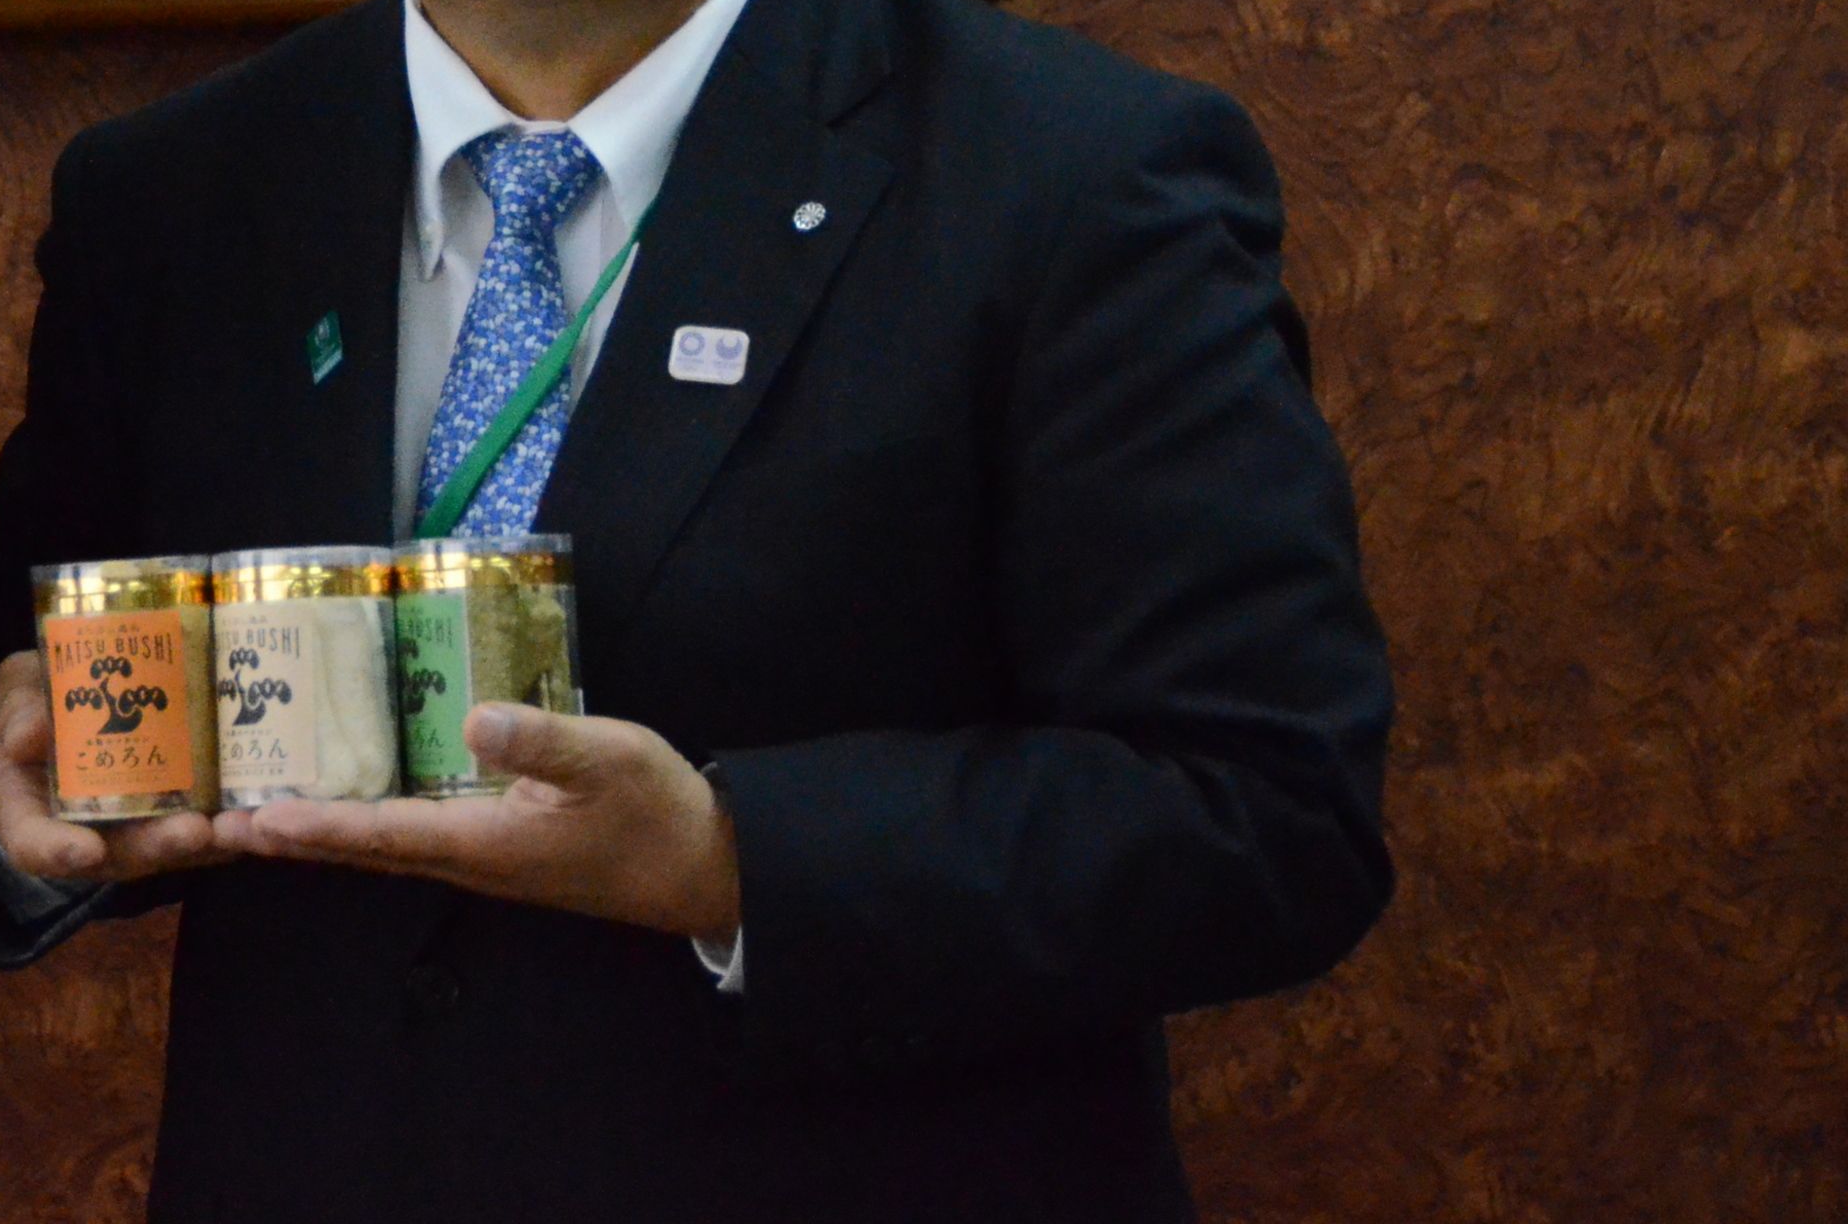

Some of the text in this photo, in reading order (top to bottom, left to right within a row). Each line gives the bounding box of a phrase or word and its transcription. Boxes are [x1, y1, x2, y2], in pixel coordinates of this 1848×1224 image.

[54, 632, 174, 673] MATSU BUSHI
[246, 624, 301, 660] BUSHI
[75, 744, 168, 771] こめろん
